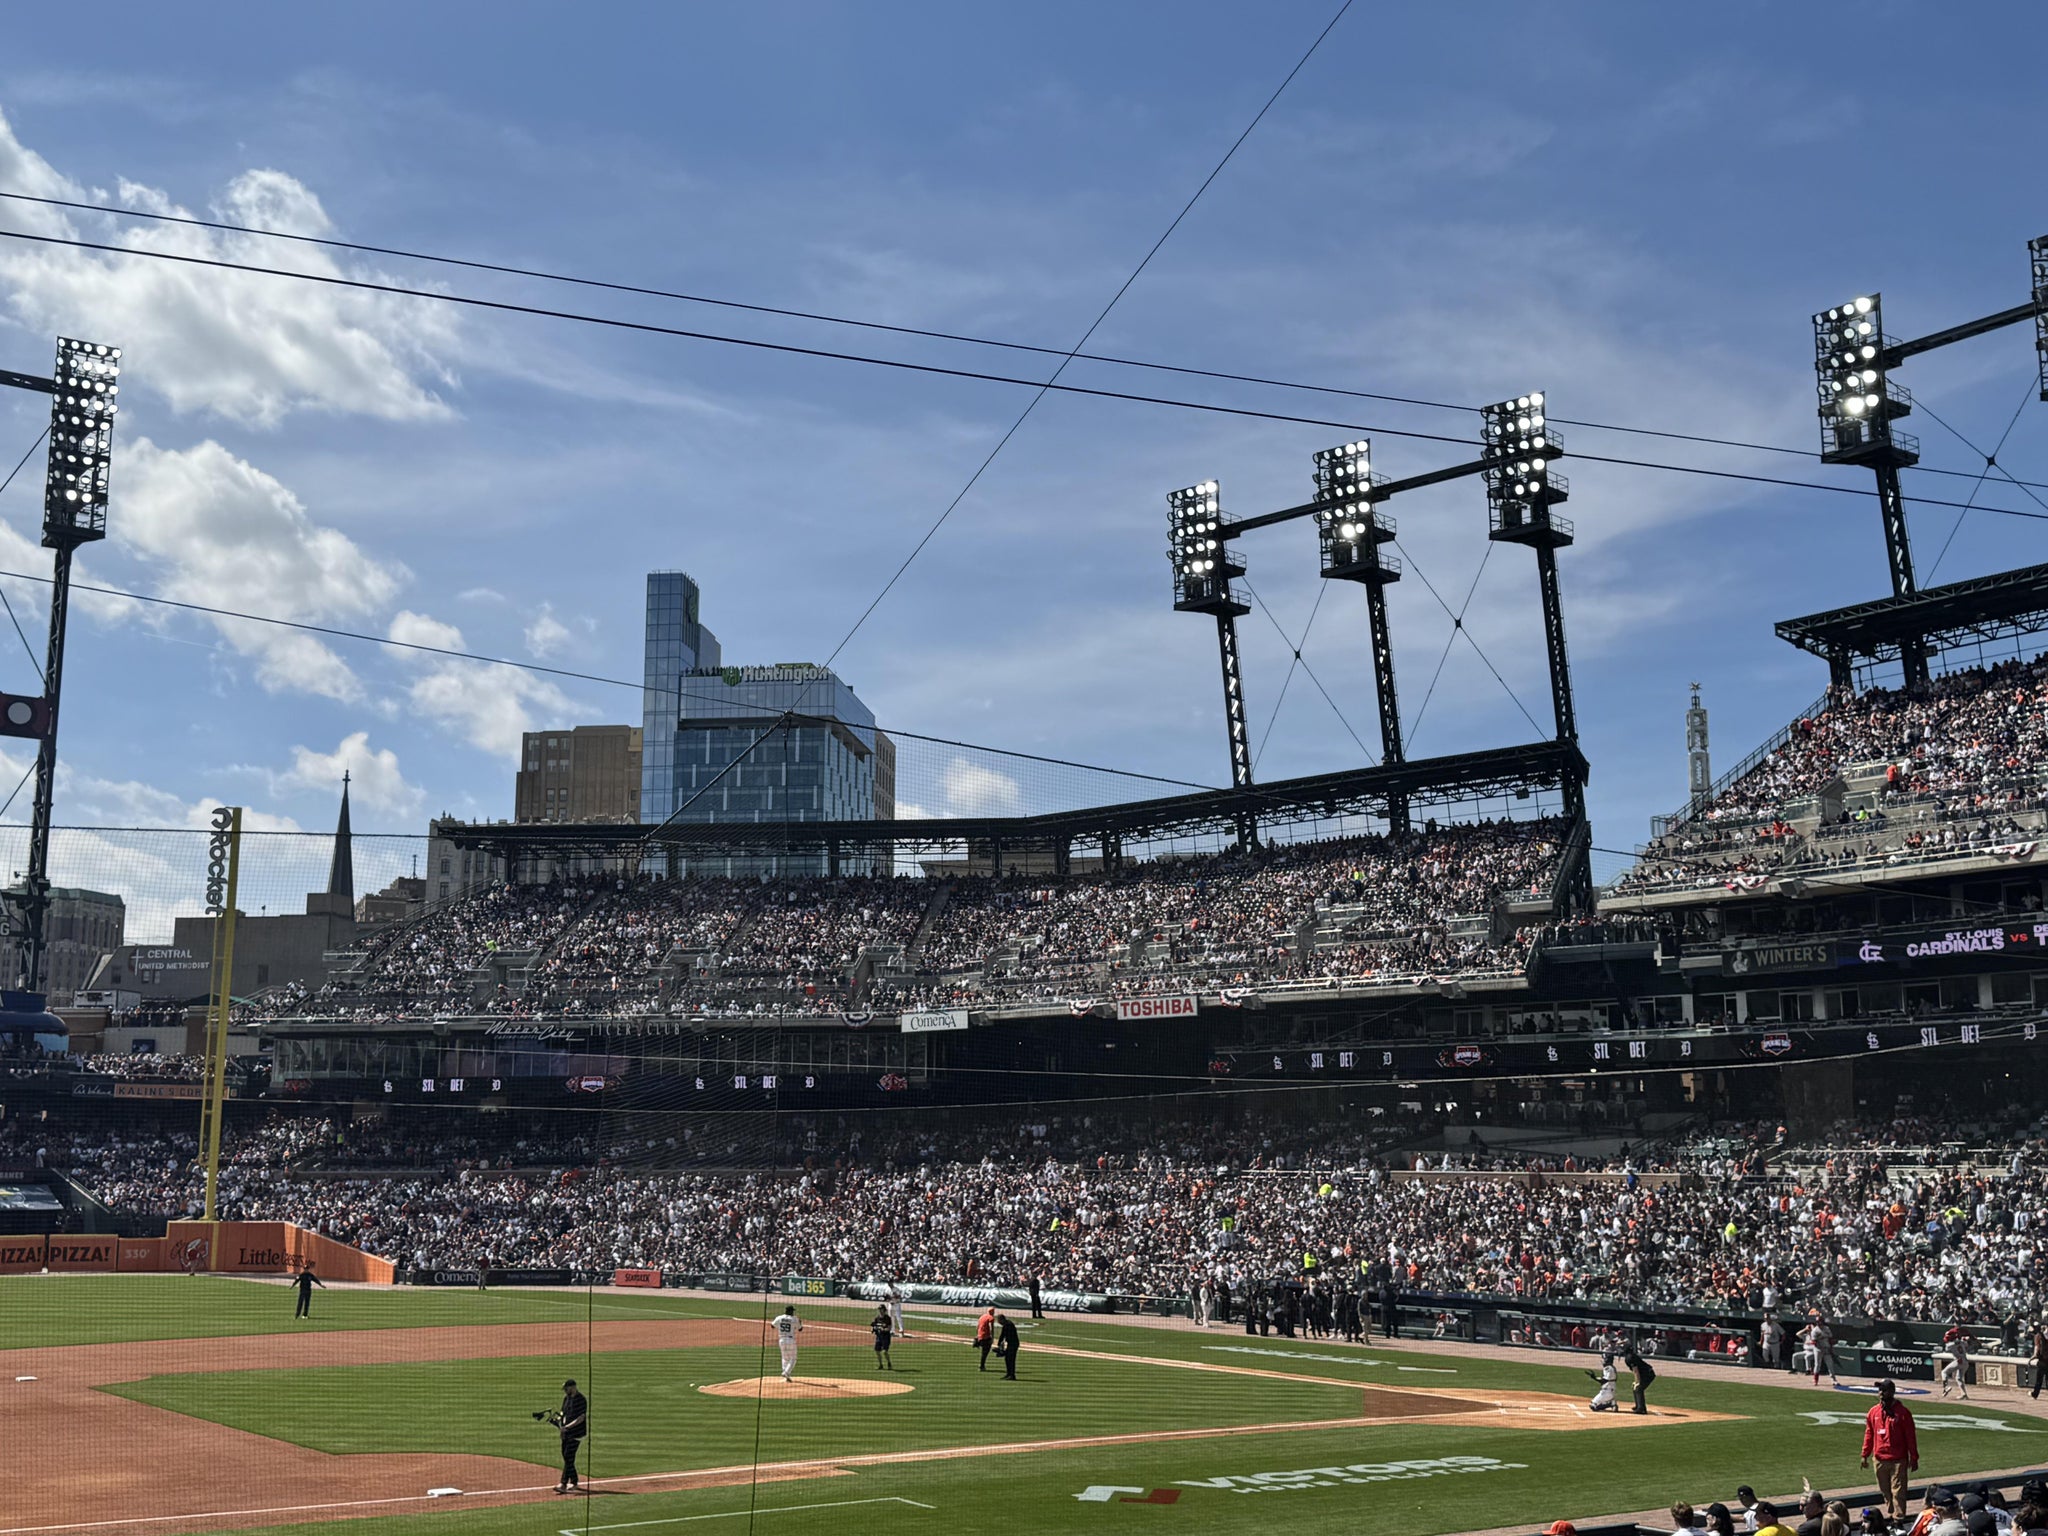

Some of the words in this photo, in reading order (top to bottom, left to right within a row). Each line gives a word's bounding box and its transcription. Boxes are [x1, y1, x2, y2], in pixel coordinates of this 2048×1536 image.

[742, 665, 829, 685] Huntington
[206, 831, 232, 917] Rocket
[147, 949, 192, 958] CENTRAL
[1906, 936, 2005, 957] CARDINALS
[1755, 945, 1827, 966] WINTER'S
[1120, 998, 1194, 1017] TOSHIBA
[647, 1022, 680, 1036] CLUB
[1920, 1027, 1939, 1046] STL
[1961, 1025, 1980, 1043] DET
[1594, 1043, 1610, 1059] STL
[1629, 1042, 1646, 1058] DET
[1311, 1053, 1324, 1068] STL
[1339, 1052, 1353, 1067] DET
[422, 1079, 435, 1091] STL
[450, 1079, 464, 1091] DET
[735, 1076, 747, 1089] STL
[763, 1076, 776, 1088] DET
[50, 1247, 112, 1262] PIZZA!
[238, 1248, 280, 1265] Little
[788, 1279, 825, 1294] bet365
[780, 1323, 791, 1332] 59
[1876, 1354, 1923, 1365] CASAMIGOS
[1887, 1364, 1912, 1374] Tequila
[1171, 1456, 1502, 1489] VICTORS
[1231, 1480, 1340, 1494] HOME
[1342, 1463, 1529, 1484] SOLUTIONS
